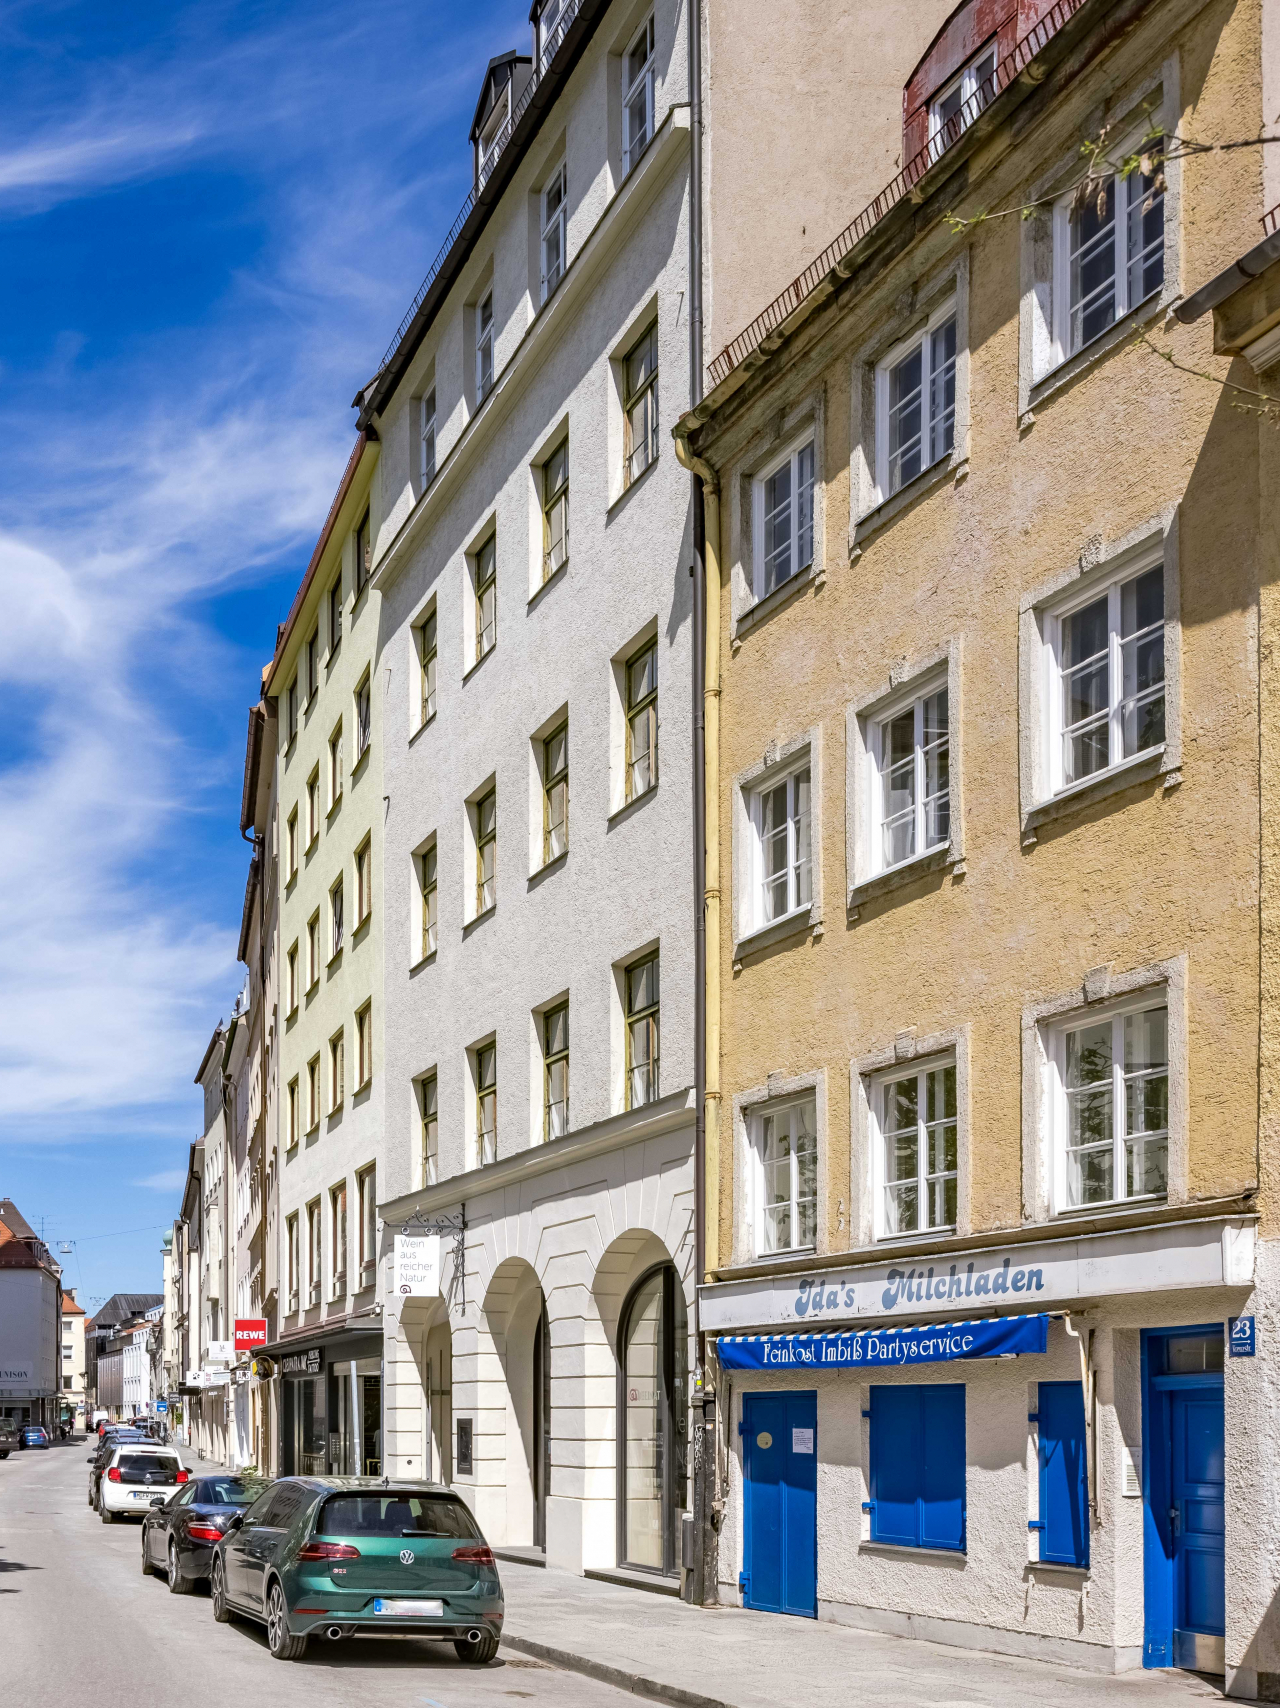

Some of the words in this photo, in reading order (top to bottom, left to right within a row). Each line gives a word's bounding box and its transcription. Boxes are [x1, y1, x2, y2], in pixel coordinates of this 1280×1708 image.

[400, 1239, 425, 1248] Wein
[400, 1251, 417, 1259] aus
[400, 1261, 433, 1270] reicher
[400, 1272, 427, 1282] Natur
[794, 1278, 856, 1317] Ida's
[881, 1257, 1045, 1310] Milchladen
[1232, 1320, 1251, 1338] 23
[236, 1331, 265, 1339] REWE
[763, 1341, 817, 1363] Feinkost
[821, 1338, 863, 1361] Imbiß
